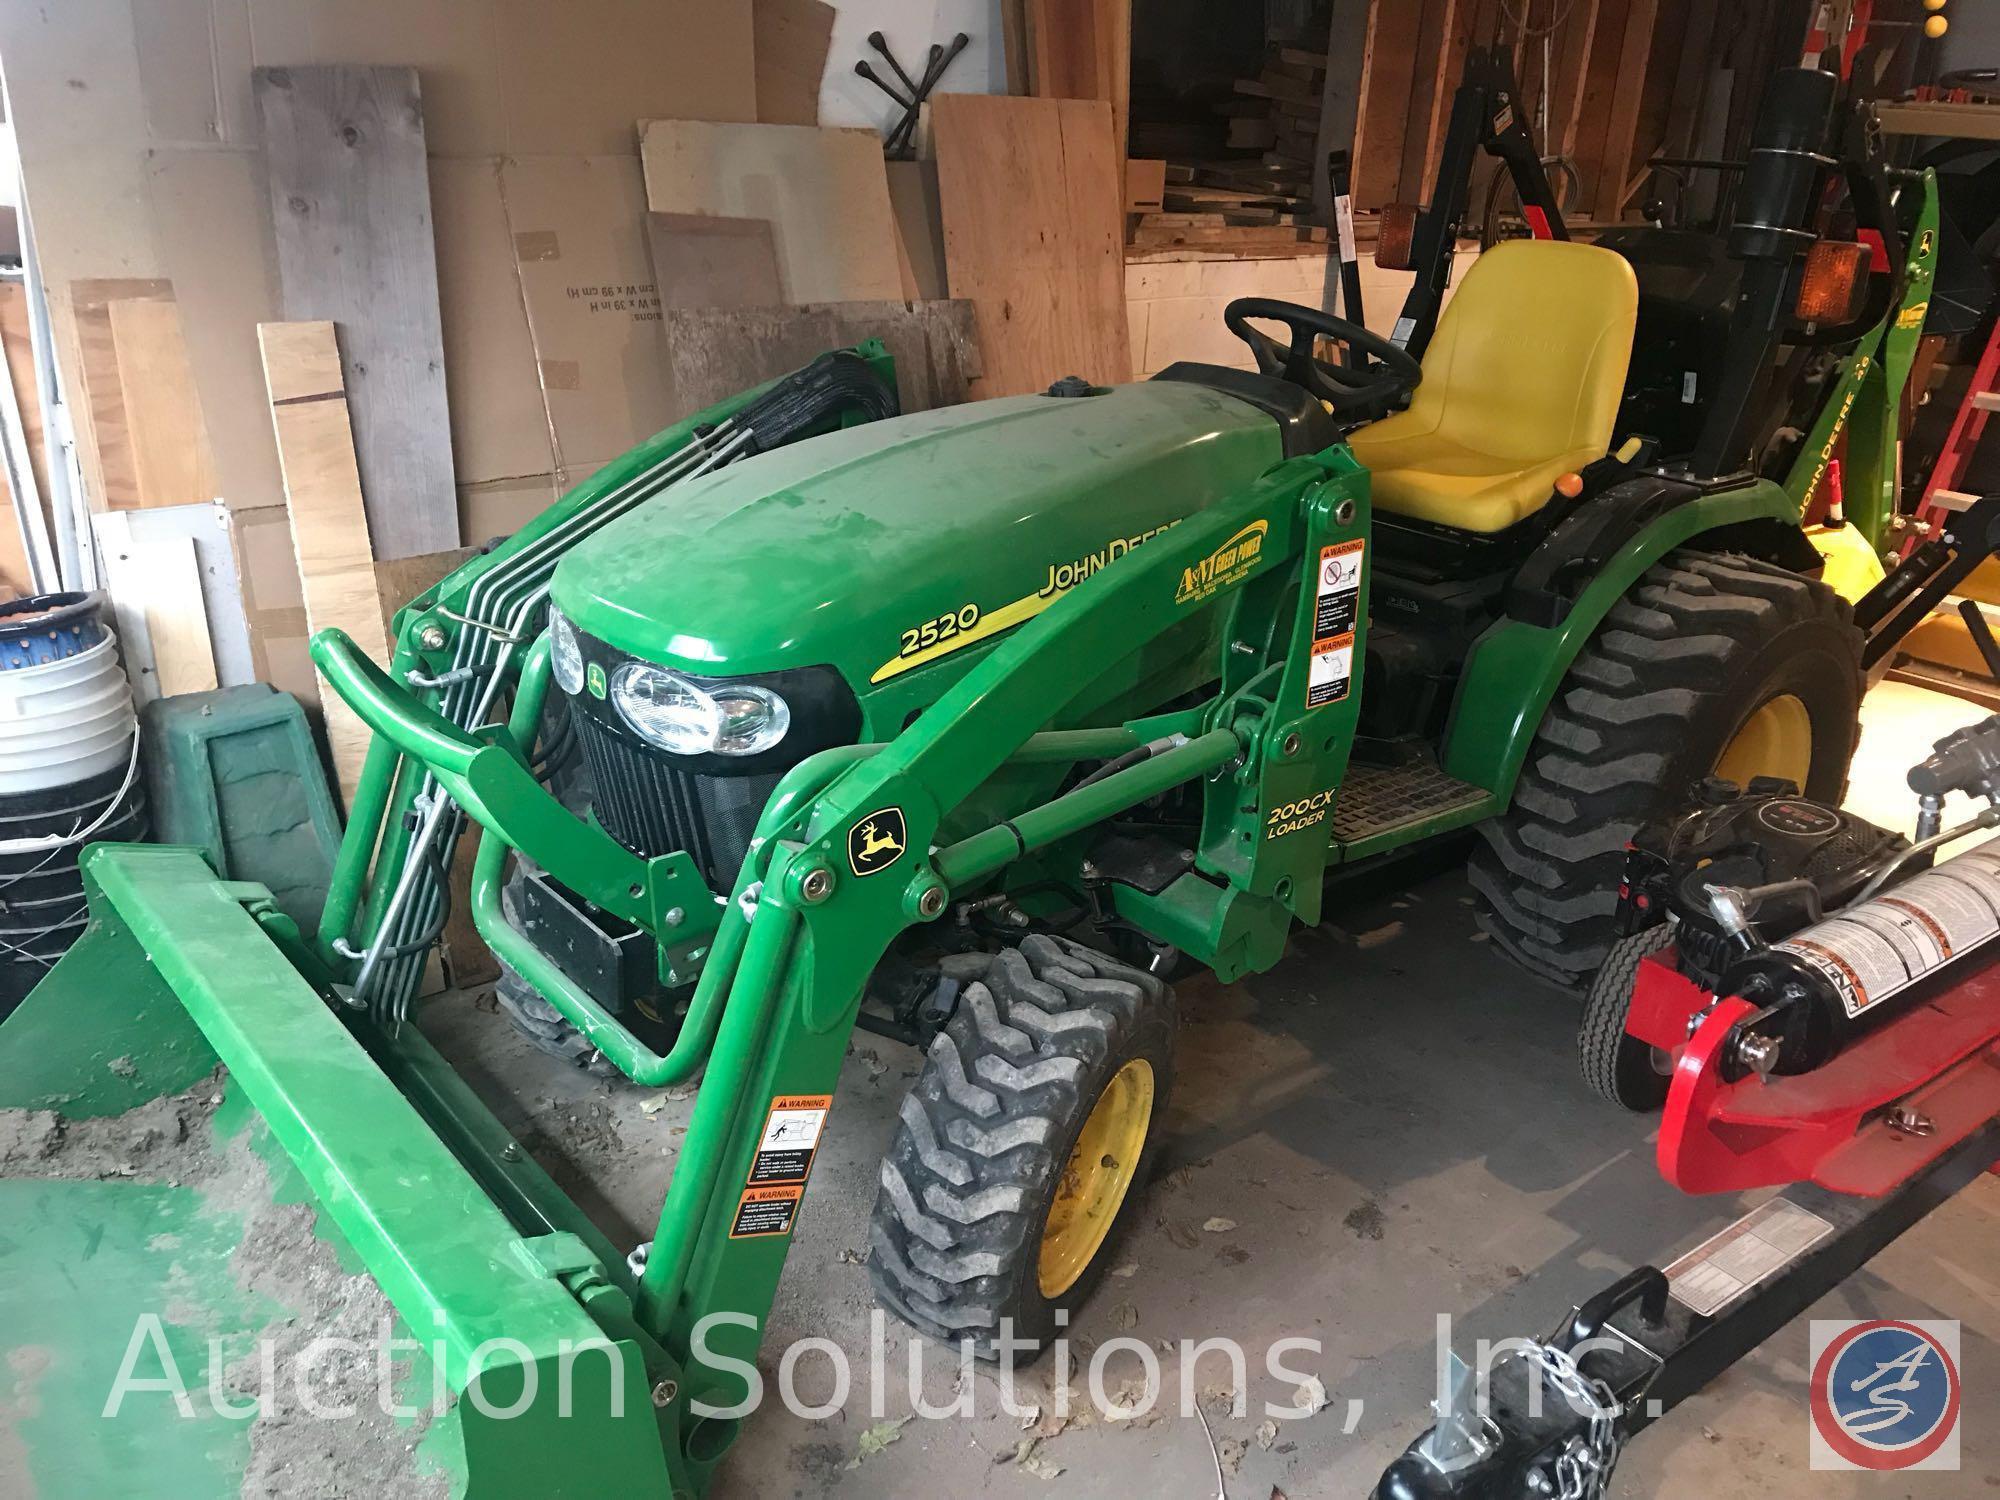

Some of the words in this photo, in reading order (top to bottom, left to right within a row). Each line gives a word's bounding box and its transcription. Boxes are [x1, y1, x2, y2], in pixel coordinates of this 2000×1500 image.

[582, 287, 599, 296] cm
[601, 287, 615, 297] 99
[626, 285, 637, 296] W
[589, 302, 599, 313] H
[613, 301, 627, 311] 39
[638, 299, 649, 309] W
[1800, 464, 1824, 519] JOHN
[1821, 391, 1855, 461] DEERE
[1330, 541, 1363, 556] WARNING
[1039, 550, 1106, 596] JOHN
[901, 602, 980, 657] 2520
[1320, 636, 1353, 652] WARNING
[1267, 788, 1336, 825] 200CX
[1267, 809, 1326, 840] LOADER
[788, 1099, 825, 1108] WARNING
[759, 1190, 796, 1199] WARNING
